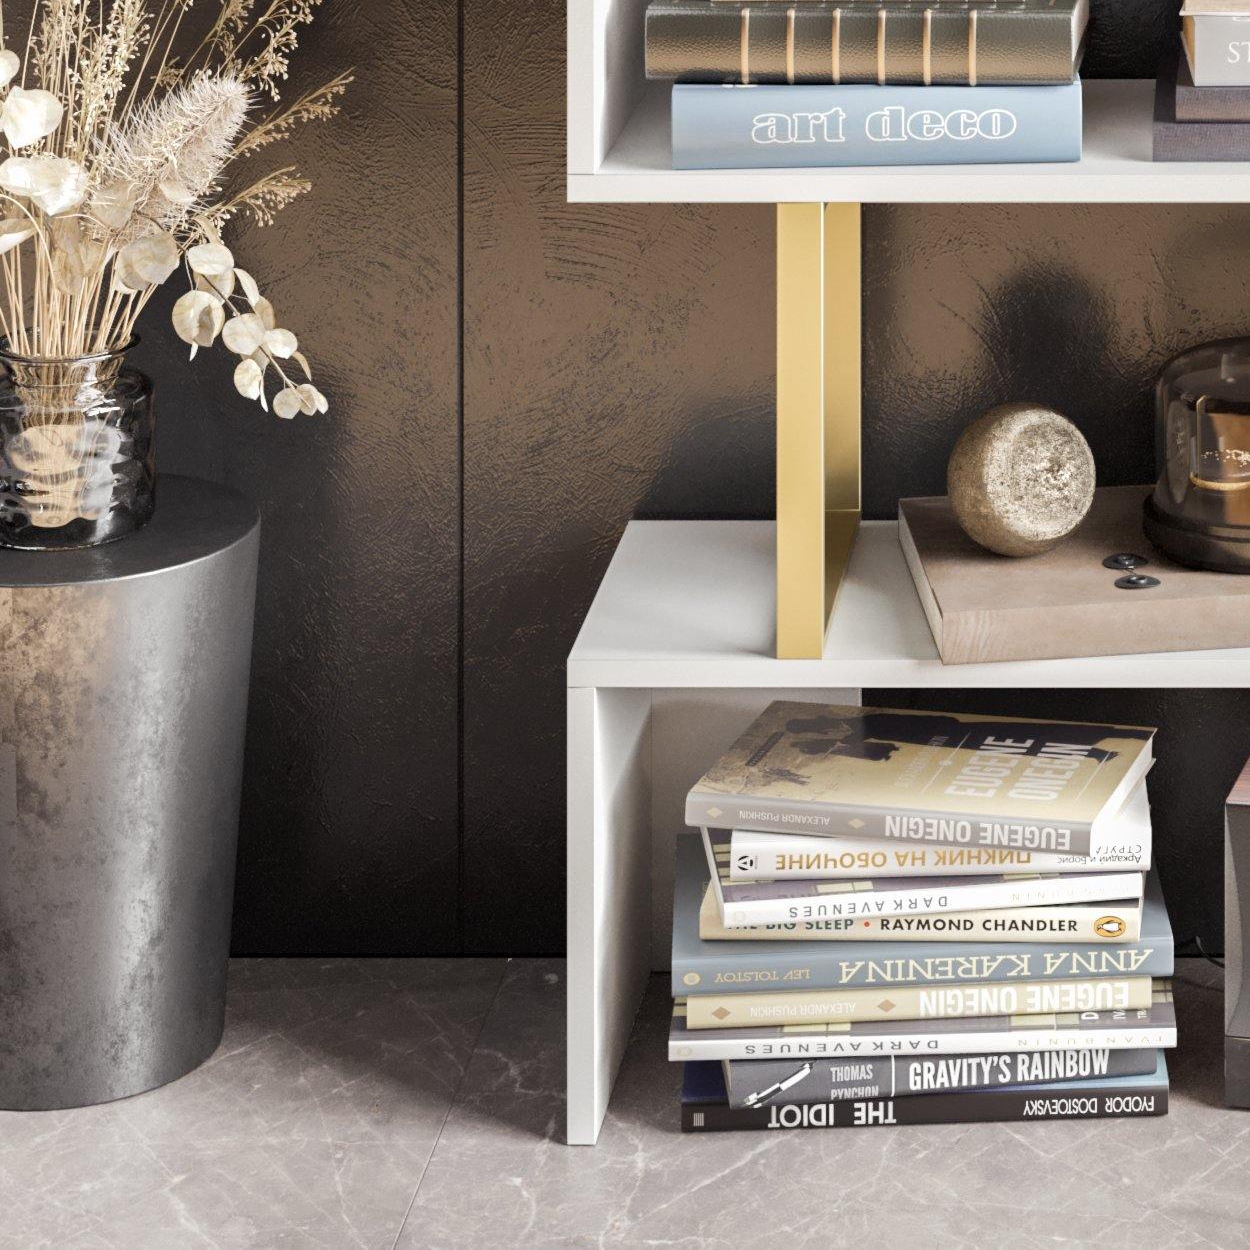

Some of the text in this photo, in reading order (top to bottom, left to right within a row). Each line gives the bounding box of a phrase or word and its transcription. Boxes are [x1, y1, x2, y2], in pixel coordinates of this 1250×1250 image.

[752, 106, 1017, 143] art deco
[944, 736, 1034, 798] EUGENE
[1007, 742, 1095, 801] ONEGIN
[739, 811, 830, 826] ALEXANDR PUSHKIN
[885, 815, 1071, 850] EUGENE ONEGIN
[775, 852, 887, 870] ОБОЧИНЕ
[894, 851, 926, 868] НА
[933, 845, 1031, 867] ПИКНИК
[1057, 855, 1087, 866] Борис
[1099, 854, 1142, 865] Аркадий
[788, 896, 947, 918] DARK AVENUES
[805, 919, 854, 930] SLEEP
[880, 919, 974, 931] RAYMOND
[982, 919, 1078, 932] CHANDLER
[715, 969, 811, 982] LEV TOLSTOY
[838, 948, 1153, 984] ANNA KARENINA
[920, 981, 1129, 1017] EUGENE ONEGIN
[750, 1002, 856, 1017] ALEXANDR PUSHKIN
[743, 1039, 938, 1054] DARK AVENUES
[830, 1064, 873, 1082] THOMAS
[909, 1049, 1110, 1090] GRAVITY'S RAINBOW
[830, 1086, 879, 1100] PYNCHON
[767, 1101, 896, 1128] THE IDIOT
[1024, 1095, 1155, 1115] FYODOR DOSTOEVSKY
